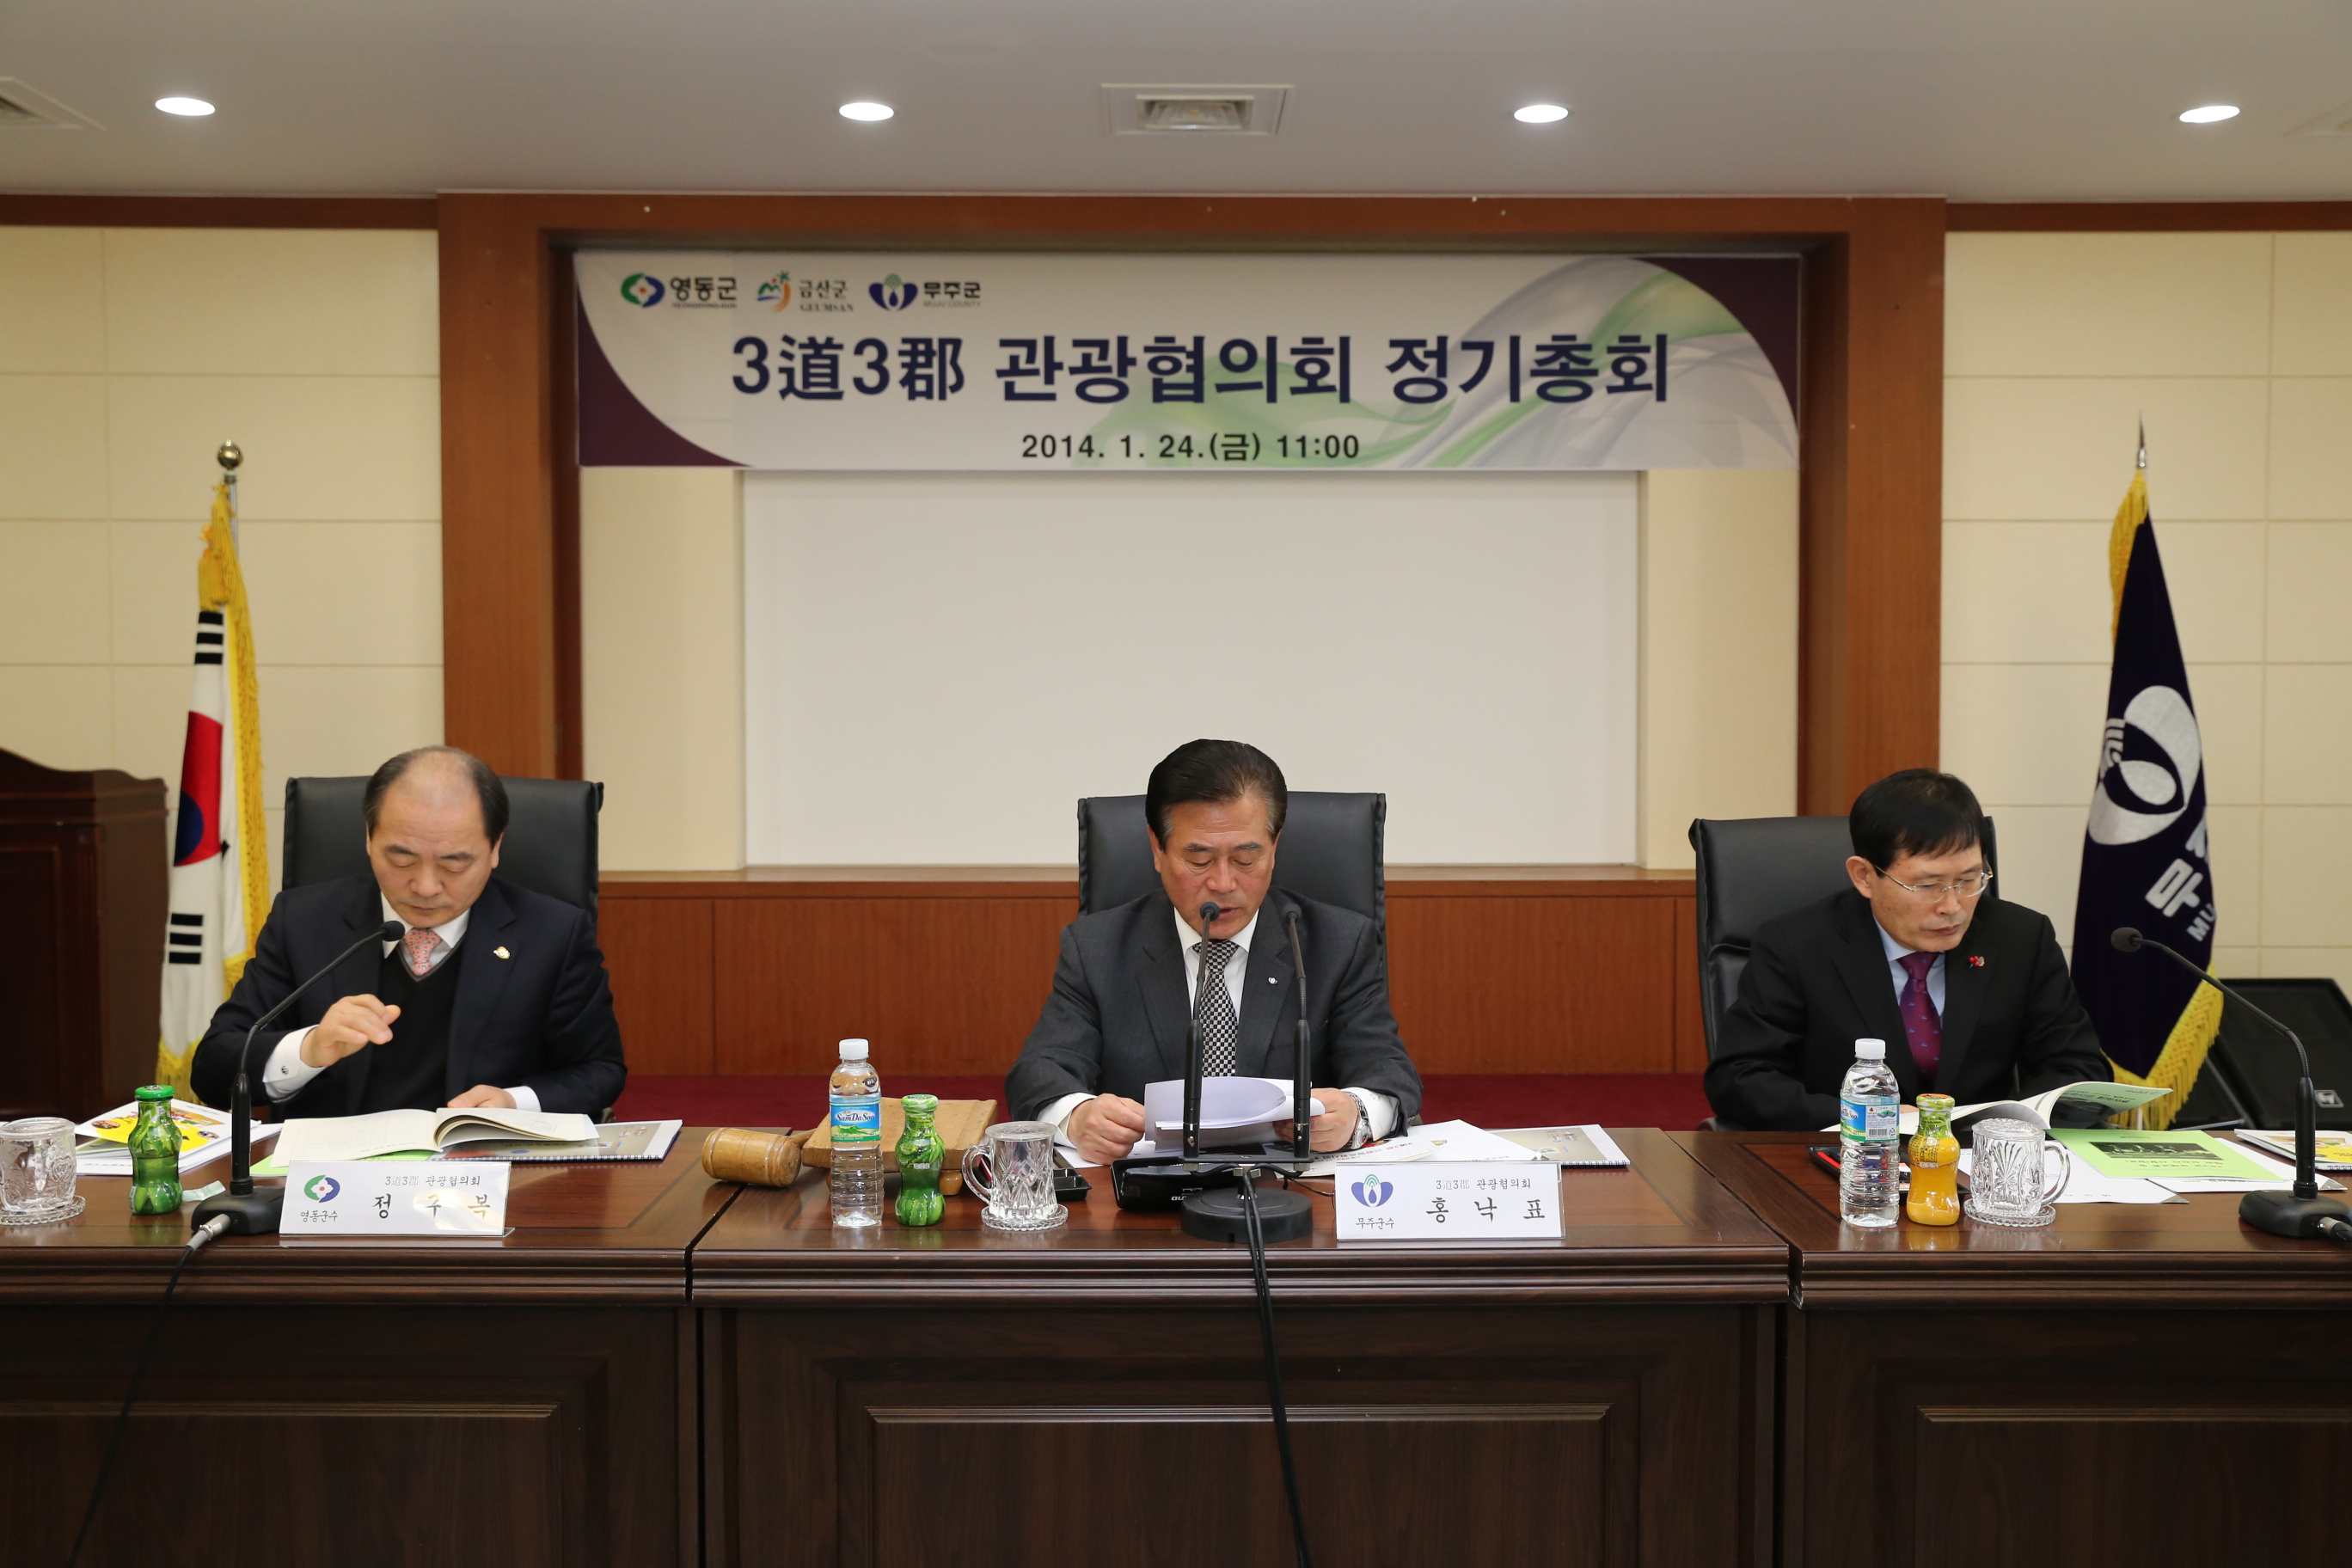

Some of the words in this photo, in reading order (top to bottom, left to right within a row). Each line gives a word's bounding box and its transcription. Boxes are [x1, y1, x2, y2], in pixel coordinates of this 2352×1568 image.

[670, 277, 737, 302] 영동군
[799, 279, 848, 299] 금산군
[923, 281, 981, 299] 무주군
[732, 334, 965, 401] 3道3郡
[995, 334, 1351, 404] 관광협의회
[1385, 333, 1669, 403] 정기총회
[1022, 433, 1105, 458] 2014.
[1120, 433, 1144, 458] 1.
[1277, 433, 1360, 459] 11:00
[385, 1175, 420, 1186] 3道3郡
[426, 1175, 481, 1187] 관광협의회
[1476, 1178, 1531, 1191] 관광협의회
[300, 1210, 339, 1223] 영동군수
[1355, 1217, 1395, 1230] 무주군수
